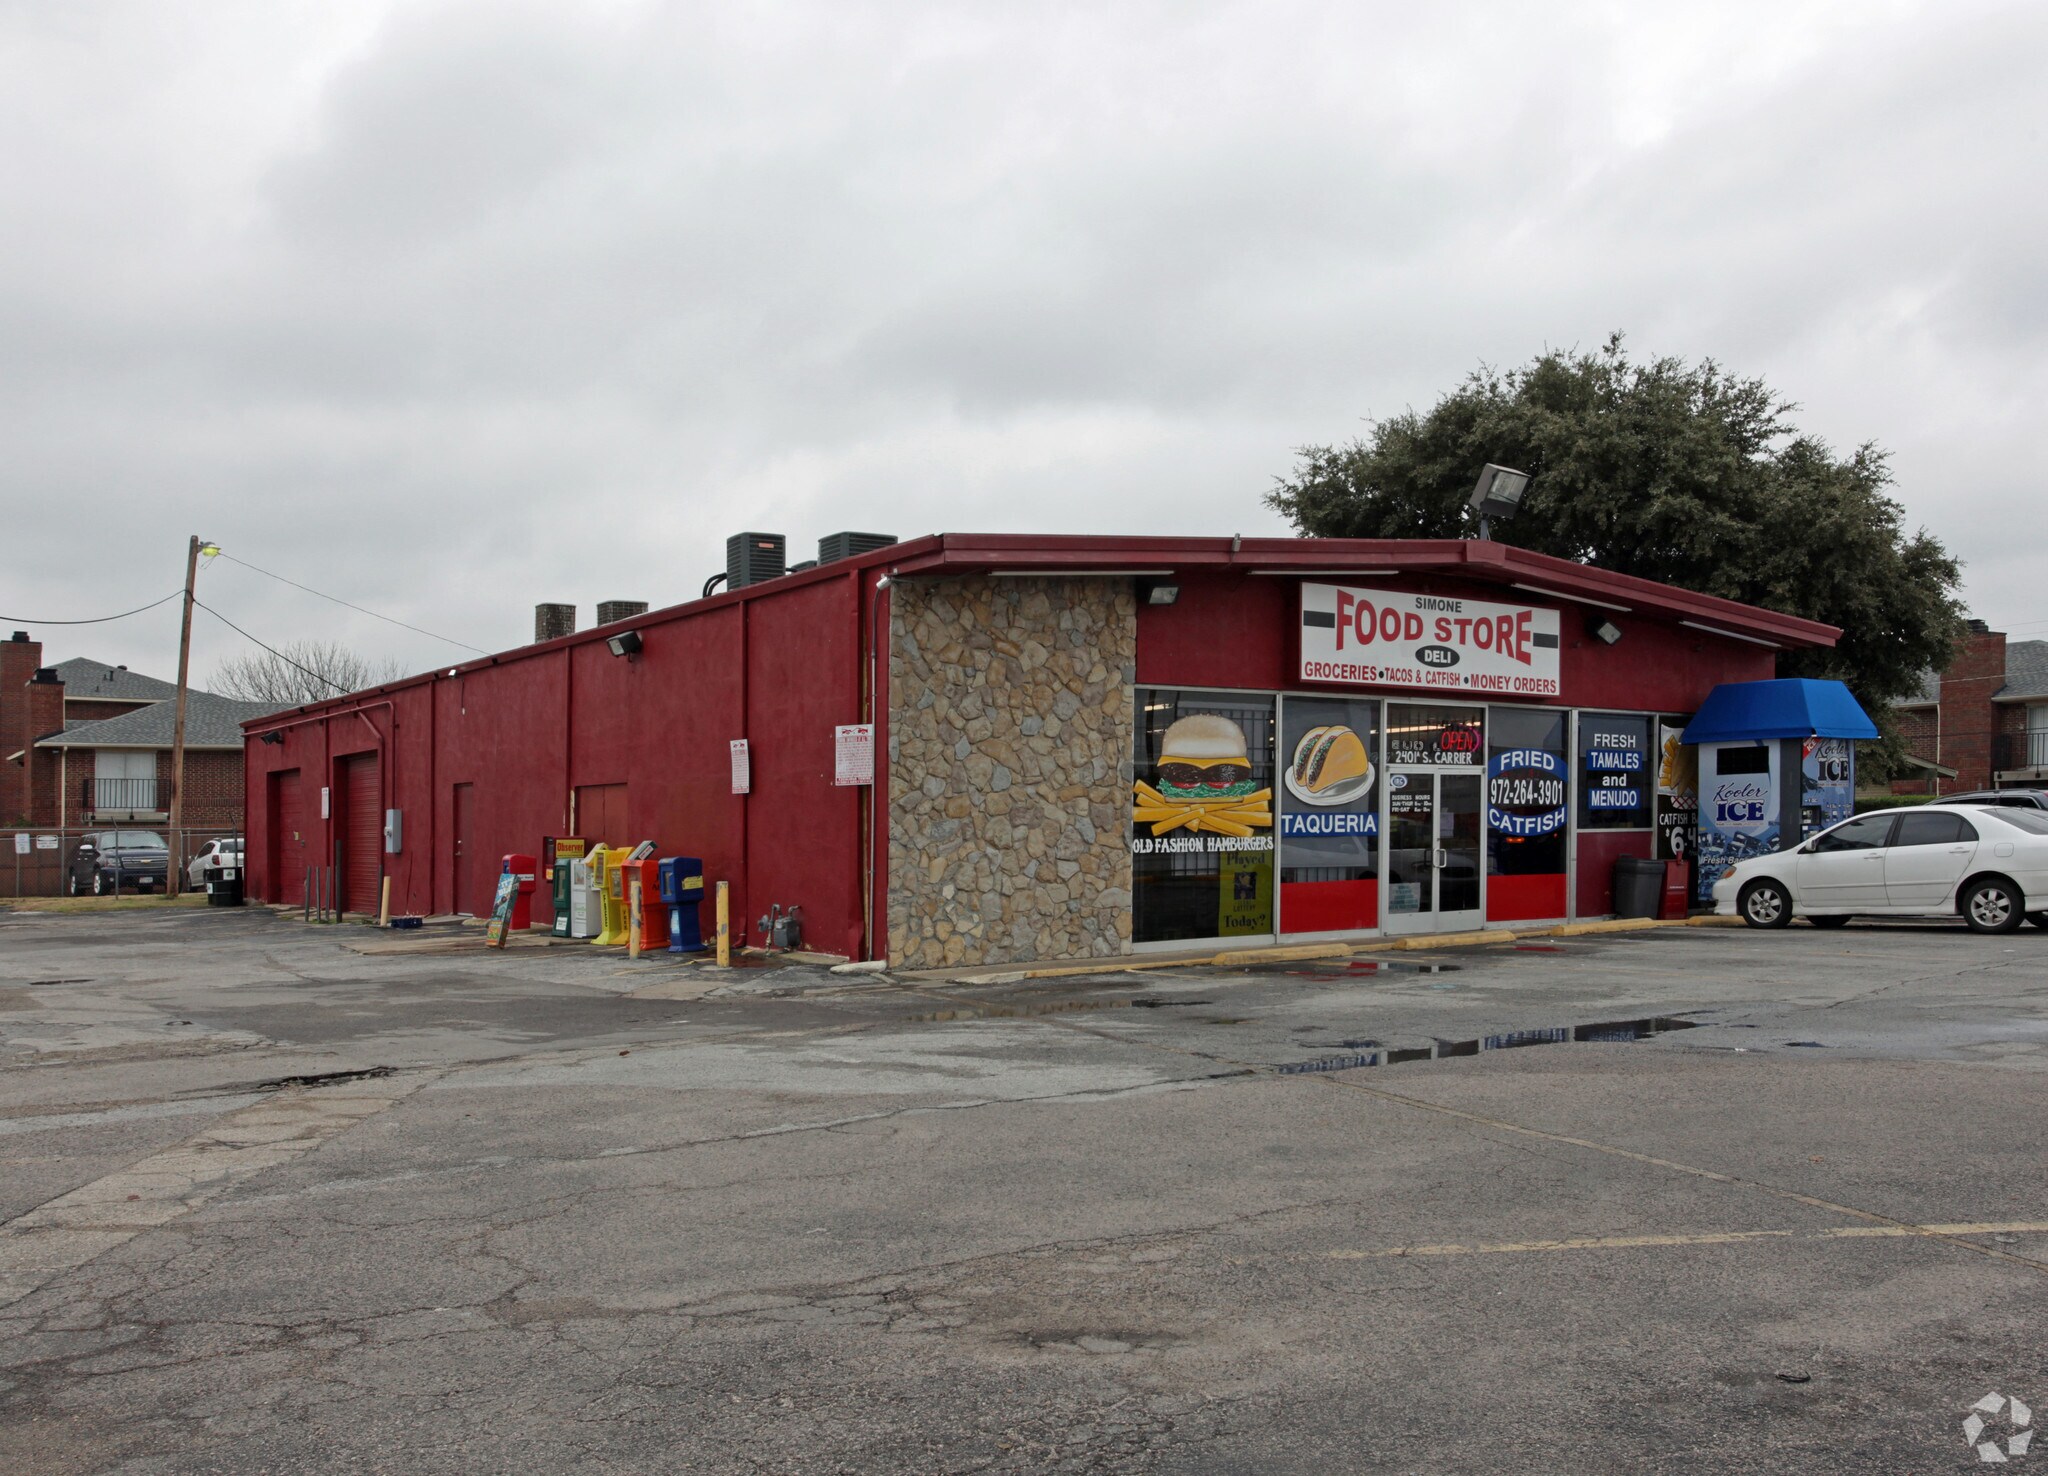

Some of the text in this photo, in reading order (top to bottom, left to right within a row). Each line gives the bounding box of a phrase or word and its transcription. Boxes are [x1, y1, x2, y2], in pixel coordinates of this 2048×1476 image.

[1415, 597, 1462, 613] SIMONE
[1336, 589, 1532, 666] FOOD STORE
[1424, 650, 1451, 663] DELI
[1304, 661, 1557, 693] GROCERIES TACOS & CATFISH MONEY ORDERS
[1441, 731, 1472, 750] OPEN
[1594, 733, 1636, 748] FRESH
[1815, 738, 1849, 758] Koole
[1422, 752, 1432, 763] S.
[1434, 752, 1472, 764] CARRIER
[1501, 750, 1554, 771] FRIED
[1591, 752, 1639, 769] TAMALES
[1818, 757, 1849, 781] ICE
[1602, 773, 1627, 786] and
[1491, 778, 1563, 805] 972-264-3901
[1591, 790, 1637, 806] MENUDO
[1713, 782, 1768, 801] Kooler
[1660, 813, 1688, 825] CATFISH
[1716, 799, 1764, 822] ICE
[1281, 814, 1376, 833] TAQUERIA
[1489, 807, 1565, 834] CATFISH
[557, 842, 583, 852] Observer
[1132, 836, 1274, 853] OLD FASHION HAMBURGERS
[1227, 852, 1265, 868] Played
[1703, 856, 1726, 864] Fresh
[1224, 914, 1265, 930] Today?
